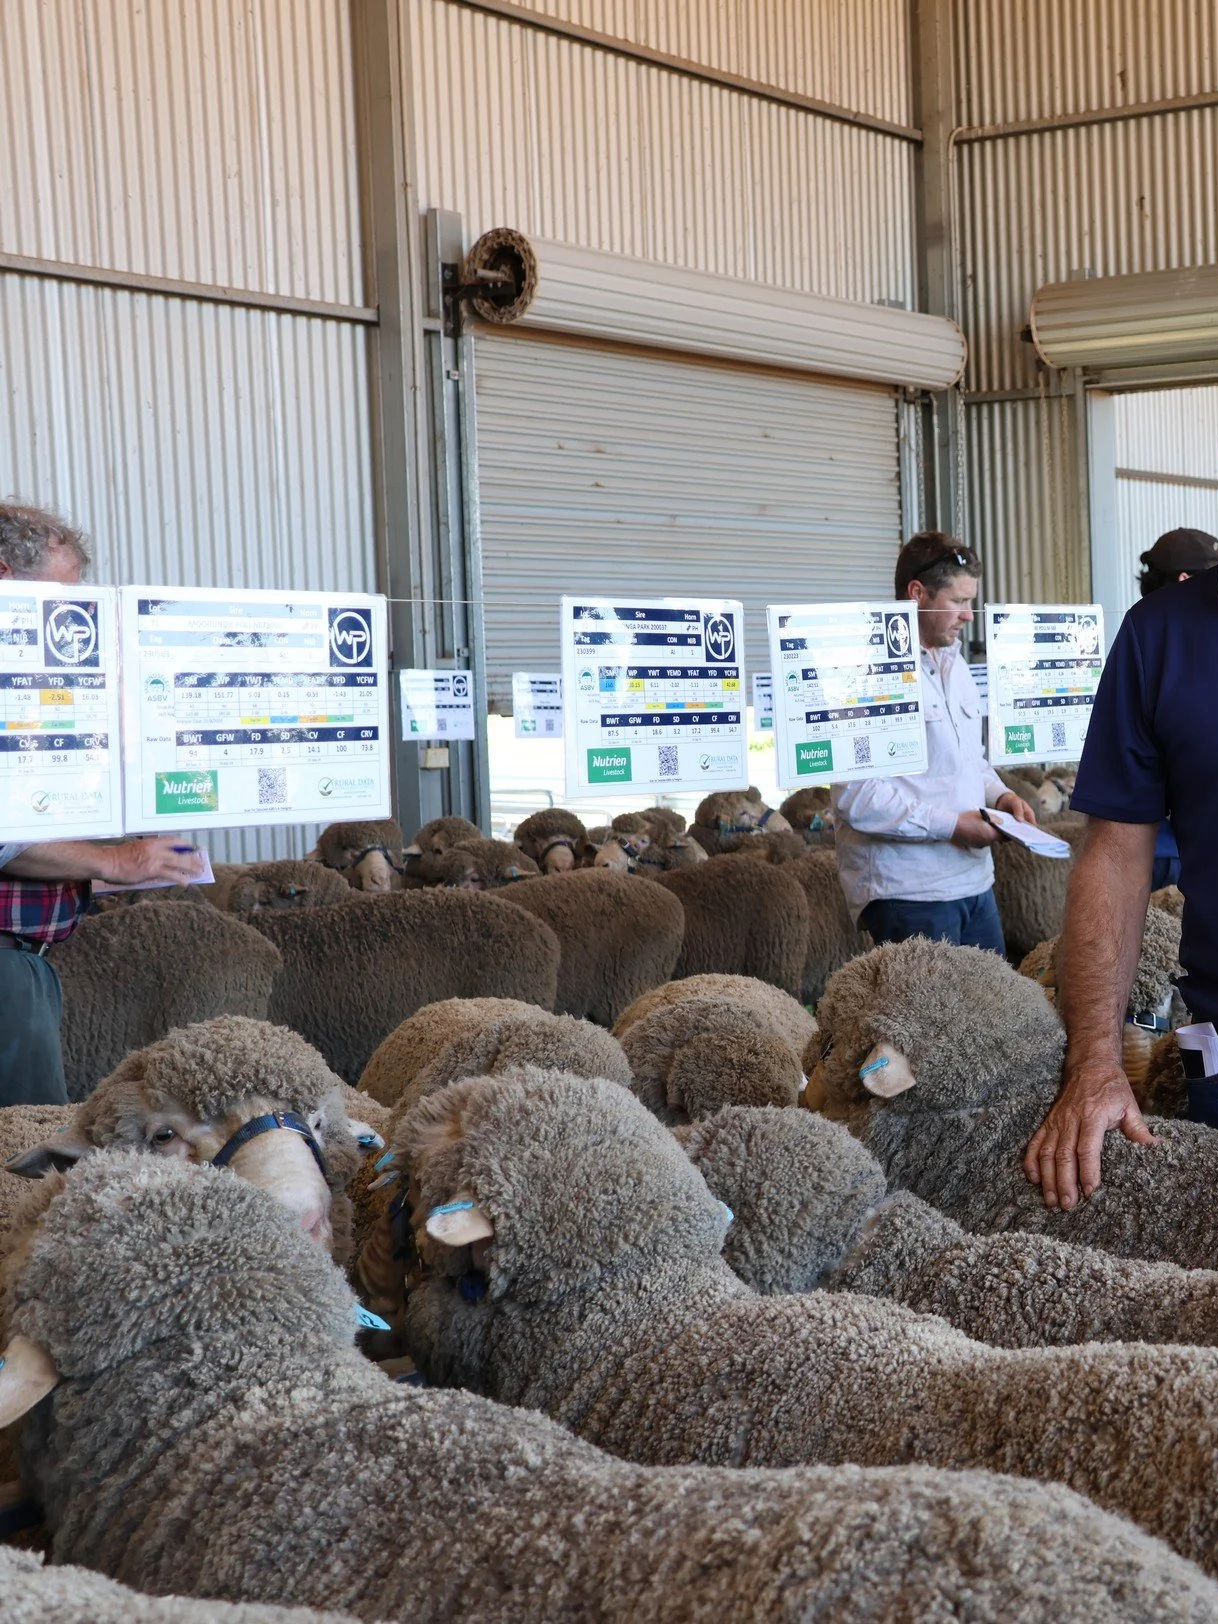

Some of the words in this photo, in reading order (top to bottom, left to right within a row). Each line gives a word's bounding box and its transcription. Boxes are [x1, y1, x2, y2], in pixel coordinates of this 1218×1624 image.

[13, 633, 28, 643] NIB
[785, 641, 794, 649] Tag
[667, 669, 682, 677] YEMD
[11, 677, 33, 686] YFAT
[48, 677, 64, 686] YFD
[78, 677, 101, 686] YCFW
[245, 676, 263, 684] YWT
[332, 676, 345, 684] YFD
[356, 676, 375, 684] YCFW
[606, 717, 620, 725] BWT
[183, 734, 203, 743] BWT
[215, 733, 235, 742] GFW
[251, 733, 261, 741] FD
[280, 732, 290, 740] SD
[309, 731, 319, 739] CV
[336, 730, 345, 738] CF
[360, 730, 374, 738] CRV
[1008, 731, 1032, 742] Nutrien
[19, 739, 31, 748] CV
[53, 738, 64, 747] CF
[84, 737, 100, 747] CRV
[800, 747, 829, 760] Nutrien
[52, 754, 68, 763] 99.8
[592, 754, 627, 767] Nutrien
[809, 760, 828, 768] Livestock
[603, 768, 625, 776] Livestock
[163, 779, 212, 795] Nutrien
[177, 796, 209, 805] Livestock
